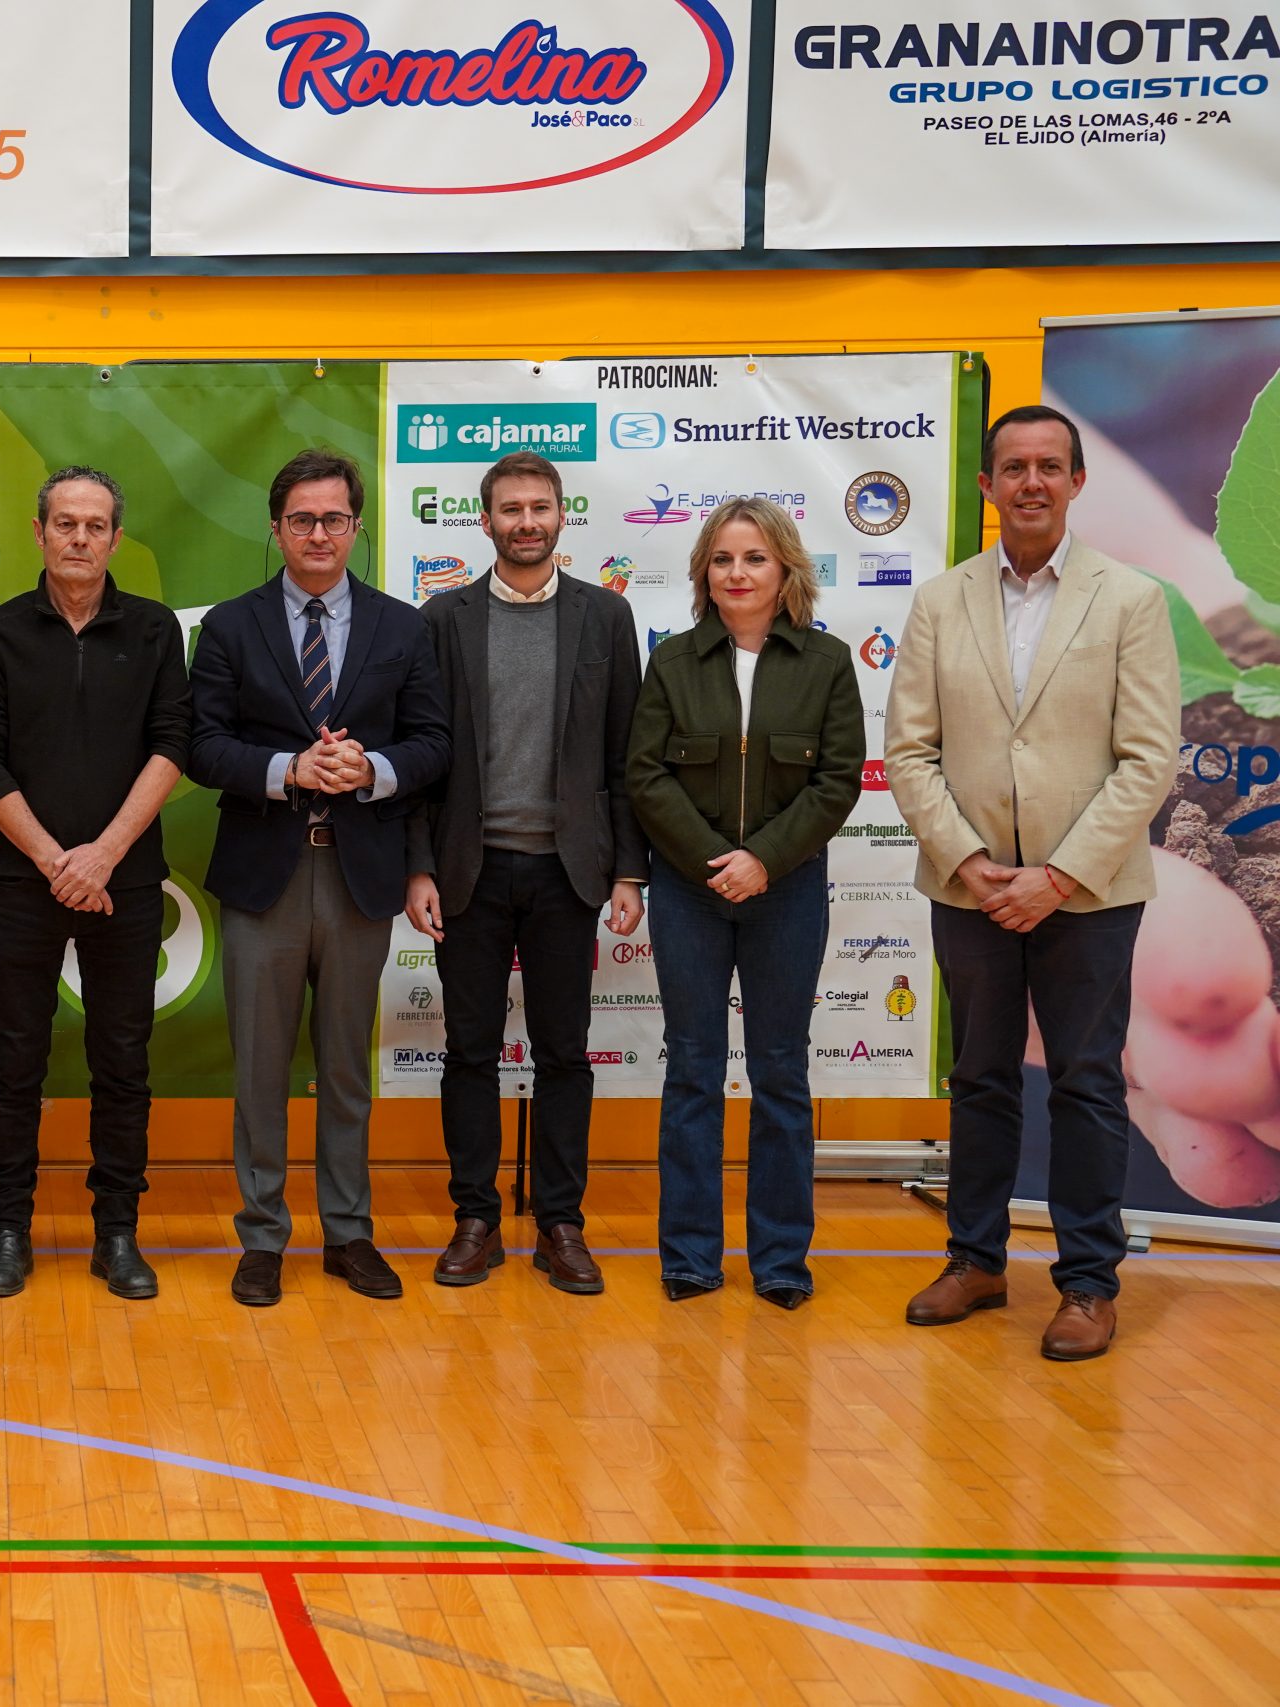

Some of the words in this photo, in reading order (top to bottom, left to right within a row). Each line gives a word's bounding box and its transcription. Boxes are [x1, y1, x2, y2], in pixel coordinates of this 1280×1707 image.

[794, 15, 1280, 69] GRANAINOTRA
[266, 13, 646, 113] Romelina
[890, 80, 1033, 103] GRUPO
[1051, 74, 1269, 100] LOGISTICO
[531, 110, 632, 127] José&Paco
[923, 116, 993, 130] PASEO
[1000, 115, 1027, 129] DE
[1033, 114, 1071, 128] LAS
[1078, 112, 1178, 128] LOMAS,46
[1197, 110, 1231, 125] 2ºA
[984, 132, 1010, 145] EL
[1016, 130, 1075, 145] EJIDO
[1081, 128, 1166, 147] (Almería)
[597, 364, 718, 389] PATROCINAN:
[456, 416, 587, 452] cajamar
[673, 416, 790, 443] Smurfit
[795, 413, 935, 440] Westrock
[520, 444, 546, 453] CAJA
[549, 443, 583, 453] RURAL
[847, 475, 878, 502] CENTRO
[564, 517, 588, 526] LUZA
[847, 507, 878, 534] CORTIJO
[878, 506, 907, 534] BLANCO
[416, 558, 458, 575] Angelo
[877, 572, 910, 580] Gaviota
[834, 823, 916, 838] emarRoqueta
[870, 839, 918, 847] CONSTRUCCIONES
[840, 891, 893, 901] CEBRIAN,
[896, 891, 916, 901] S.L.
[843, 936, 910, 947] FERREERÍA
[835, 950, 856, 959] José
[893, 950, 917, 959] Moro
[826, 991, 868, 1002] Colegial
